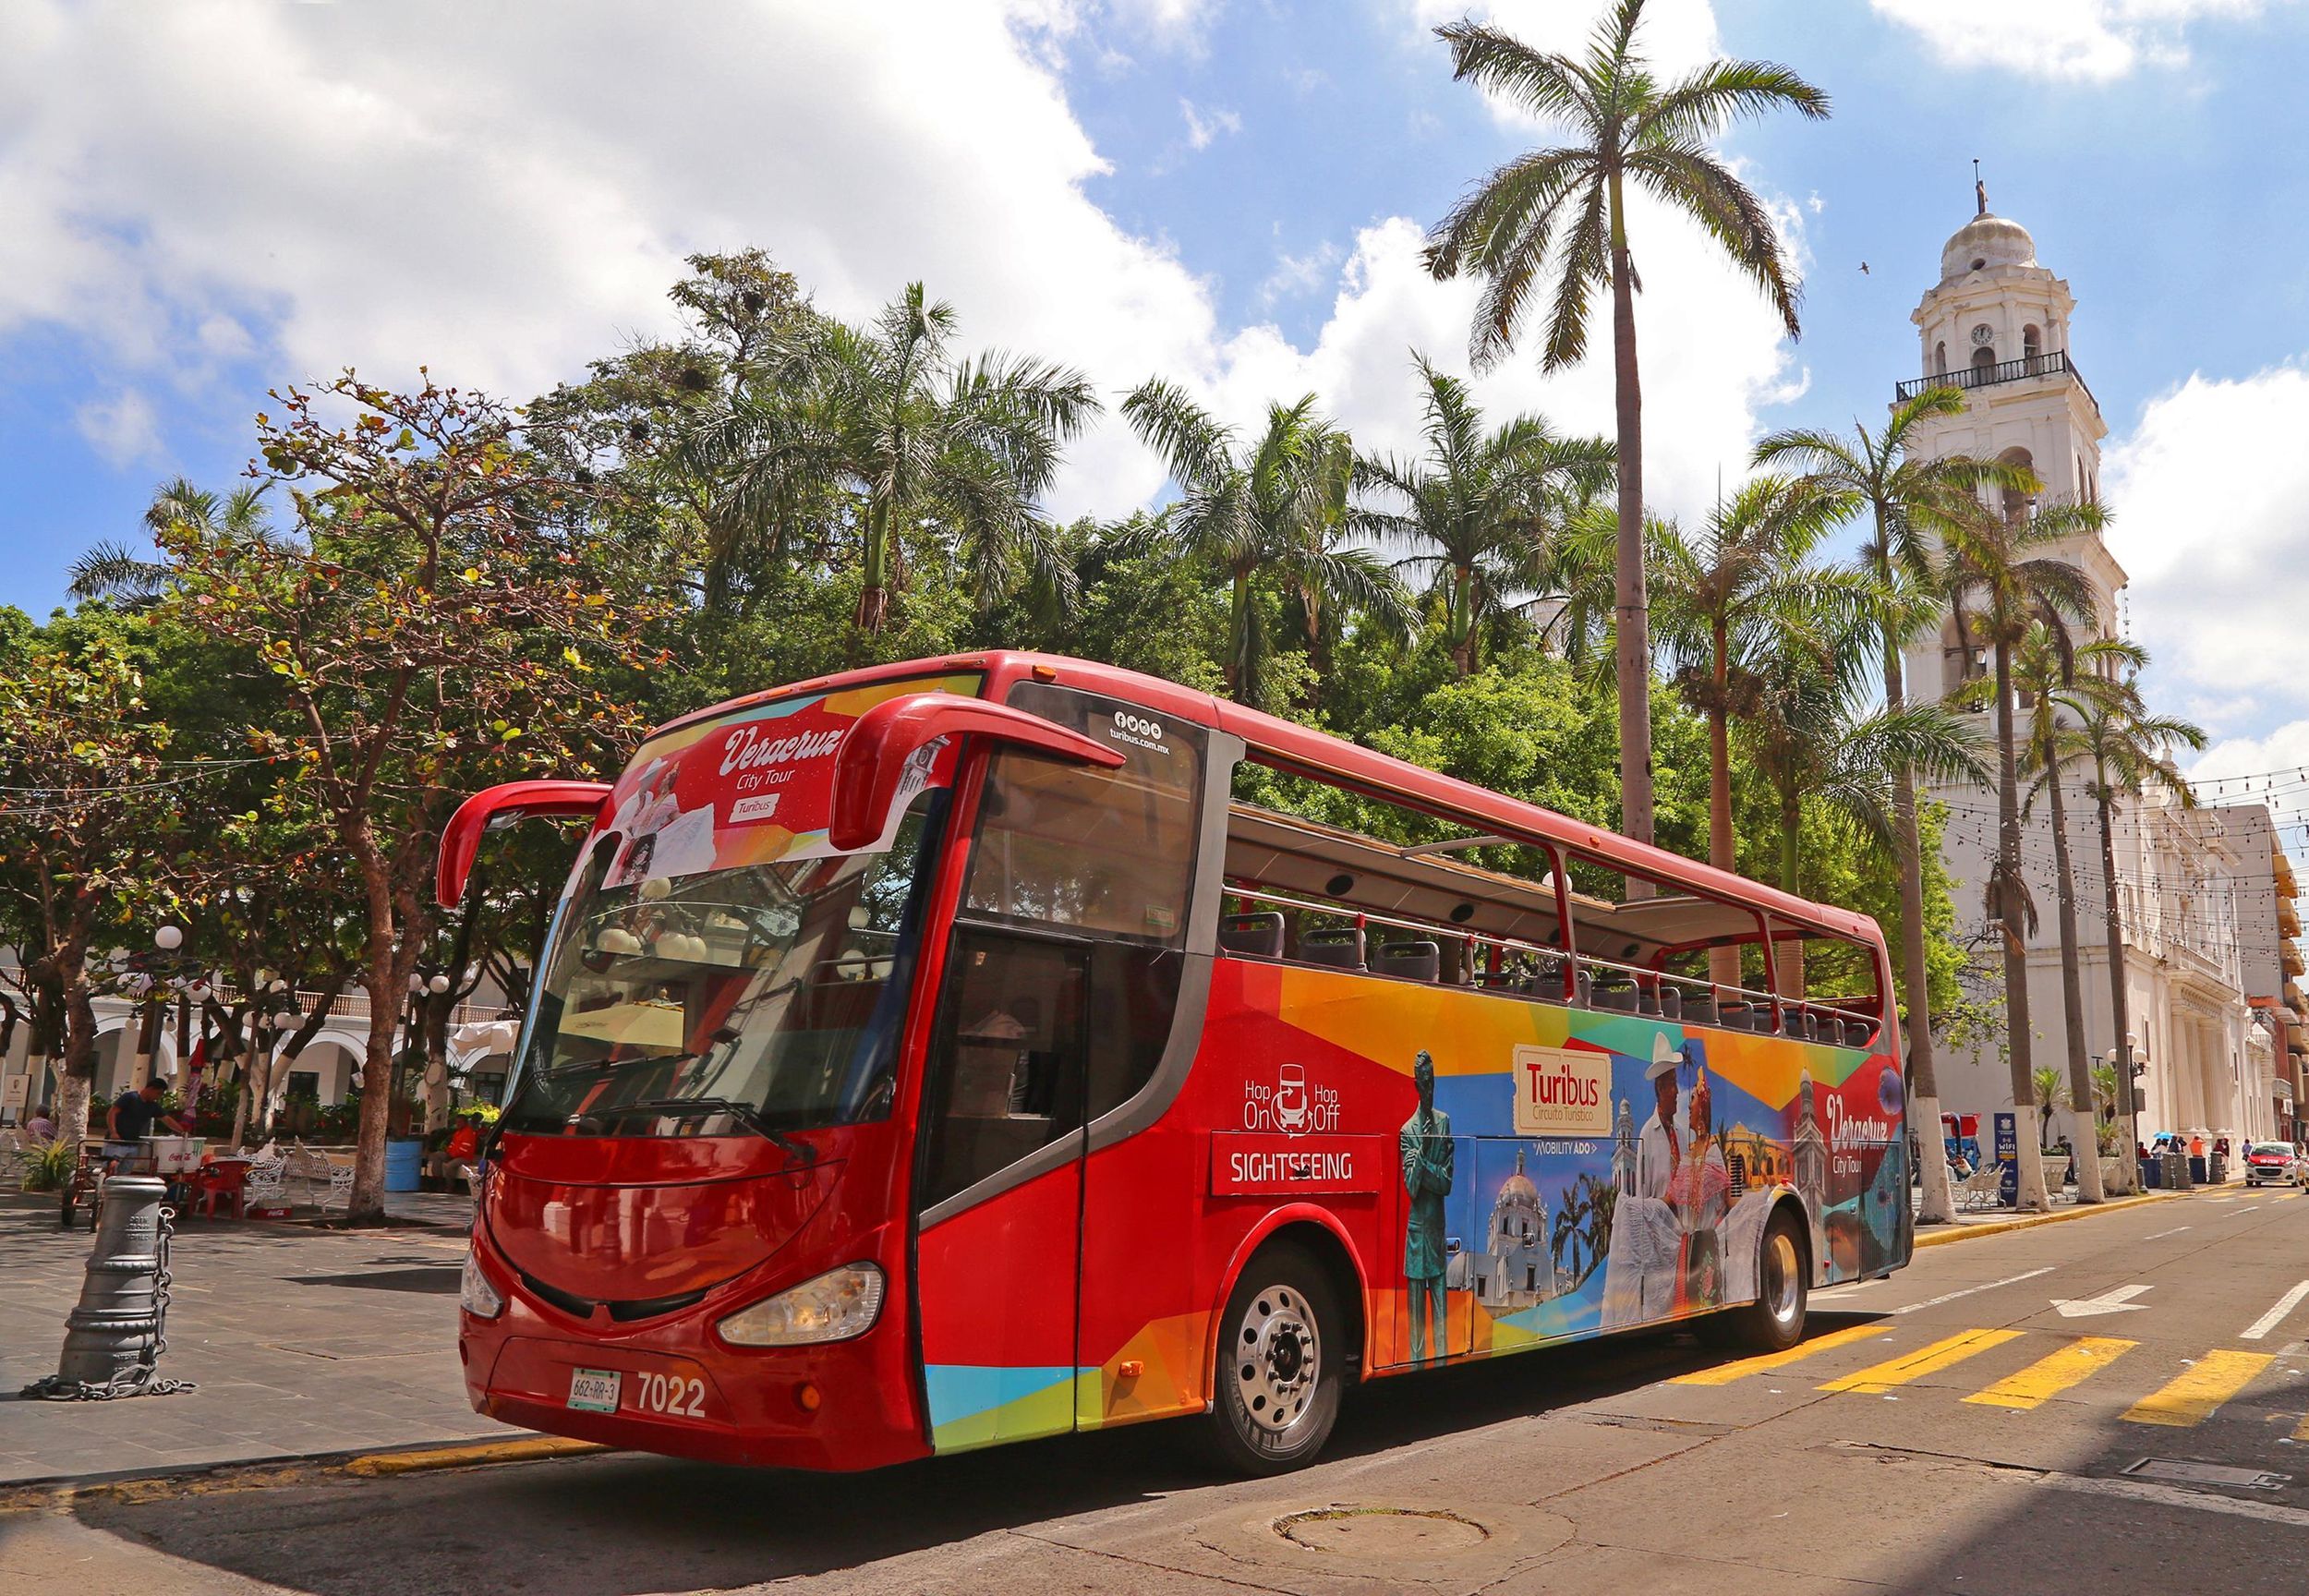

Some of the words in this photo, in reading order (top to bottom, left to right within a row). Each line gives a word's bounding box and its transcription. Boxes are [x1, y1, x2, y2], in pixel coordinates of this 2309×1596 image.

[719, 725, 845, 777] Veracruz
[1109, 727, 1170, 756] turibus.com.mx
[736, 771, 764, 792] City
[765, 768, 796, 785] Tour
[738, 800, 771, 815] Turibus
[1244, 1079, 1271, 1105] Hop
[1314, 1083, 1338, 1106] Hop
[1527, 1063, 1599, 1106] Turibus
[1243, 1100, 1270, 1130] On
[1313, 1104, 1341, 1131] Off
[1532, 1104, 1563, 1121] Circuito
[1826, 1094, 1889, 1154] Veracruz
[1535, 1141, 1573, 1156] MOBILITY
[1573, 1142, 1590, 1155] ADO
[1230, 1152, 1353, 1183] SIGHTSEEING
[1832, 1155, 1847, 1178] City
[1847, 1155, 1862, 1173] Tour
[637, 1371, 706, 1418] 7022
